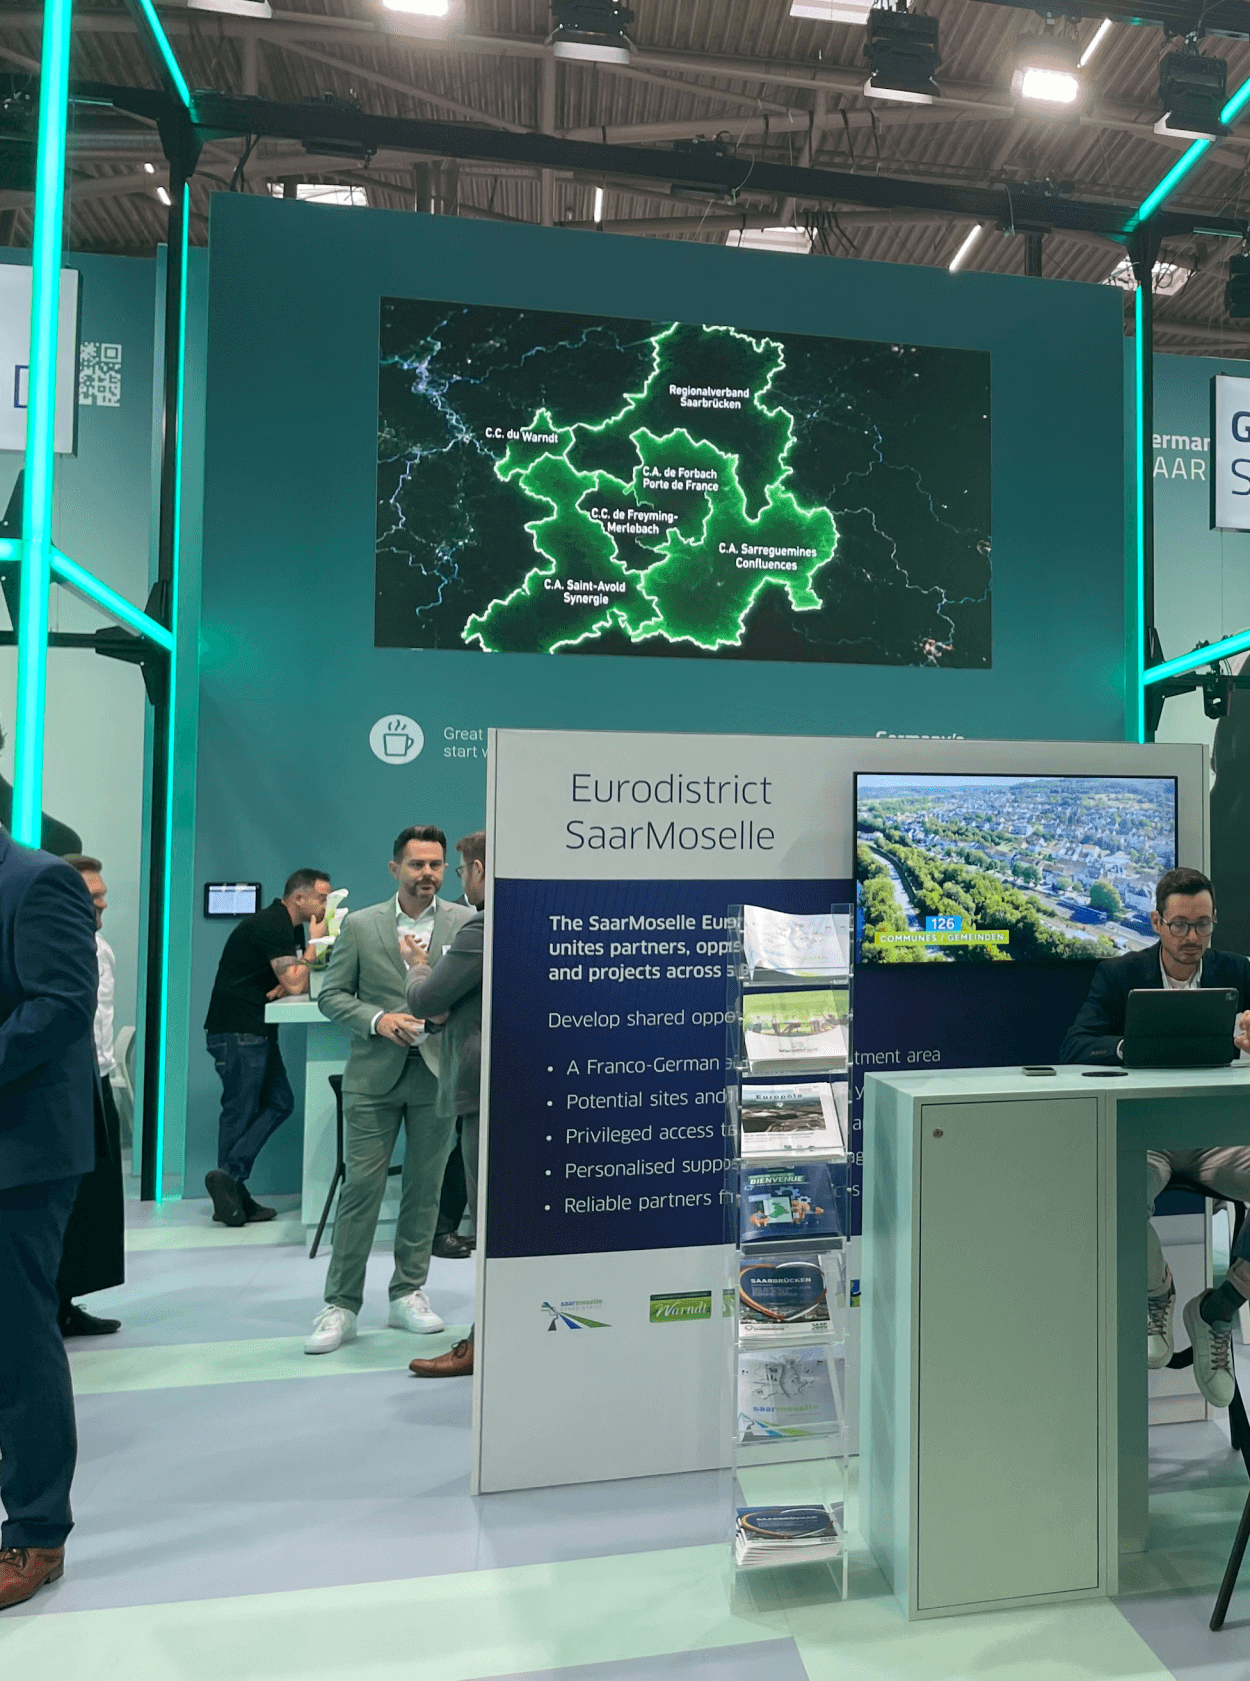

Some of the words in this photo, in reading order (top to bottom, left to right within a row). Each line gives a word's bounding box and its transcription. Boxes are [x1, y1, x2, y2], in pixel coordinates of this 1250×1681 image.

[669, 384, 750, 398] Regionalverband
[680, 396, 741, 410] Saarbrücken
[485, 427, 504, 439] C.C.
[507, 429, 520, 440] du
[522, 431, 558, 443] Warndt
[643, 466, 661, 478] C.A.
[663, 467, 676, 478] de
[678, 467, 717, 479] Forbach
[643, 478, 669, 490] Porte
[672, 479, 683, 490] de
[685, 481, 719, 492] France
[591, 508, 610, 519] C.C.
[613, 509, 625, 520] de
[628, 510, 678, 523] Freyming-
[607, 522, 660, 535] Merlebach
[719, 543, 738, 554] C.A.
[741, 543, 817, 557] Sarreguemines
[735, 558, 798, 571] Confluences
[544, 579, 564, 590] C.A.
[566, 580, 626, 592] Saint-Avold
[563, 592, 609, 605] Synergie
[443, 726, 483, 741] Great
[443, 745, 477, 758] start
[571, 772, 773, 805] Eurodistrict
[565, 819, 777, 852] SaarMoselle
[549, 915, 583, 931] The
[589, 914, 696, 931] SaarMoselle
[931, 917, 955, 930] 126
[880, 934, 937, 943] COMMUNES
[947, 933, 1004, 942] GEMEINDEN
[549, 939, 604, 956] unites
[610, 939, 690, 958] partners,
[549, 964, 582, 981] and
[588, 963, 660, 983] projects
[666, 964, 722, 980] across
[548, 1011, 620, 1029] Develop
[627, 1009, 685, 1027] shared
[566, 1059, 580, 1075] A
[587, 1057, 720, 1075] Franco-German
[854, 1048, 901, 1065] tment
[907, 1050, 941, 1063] area
[566, 1091, 643, 1110] Potential
[650, 1090, 688, 1107] sites
[694, 1088, 726, 1105] and
[565, 1125, 653, 1145] Privileged
[659, 1125, 714, 1141] access
[565, 1158, 676, 1179] Personalised
[750, 1175, 803, 1185] BIENVENUE
[564, 1195, 632, 1214] Reliable
[639, 1192, 712, 1212] partners
